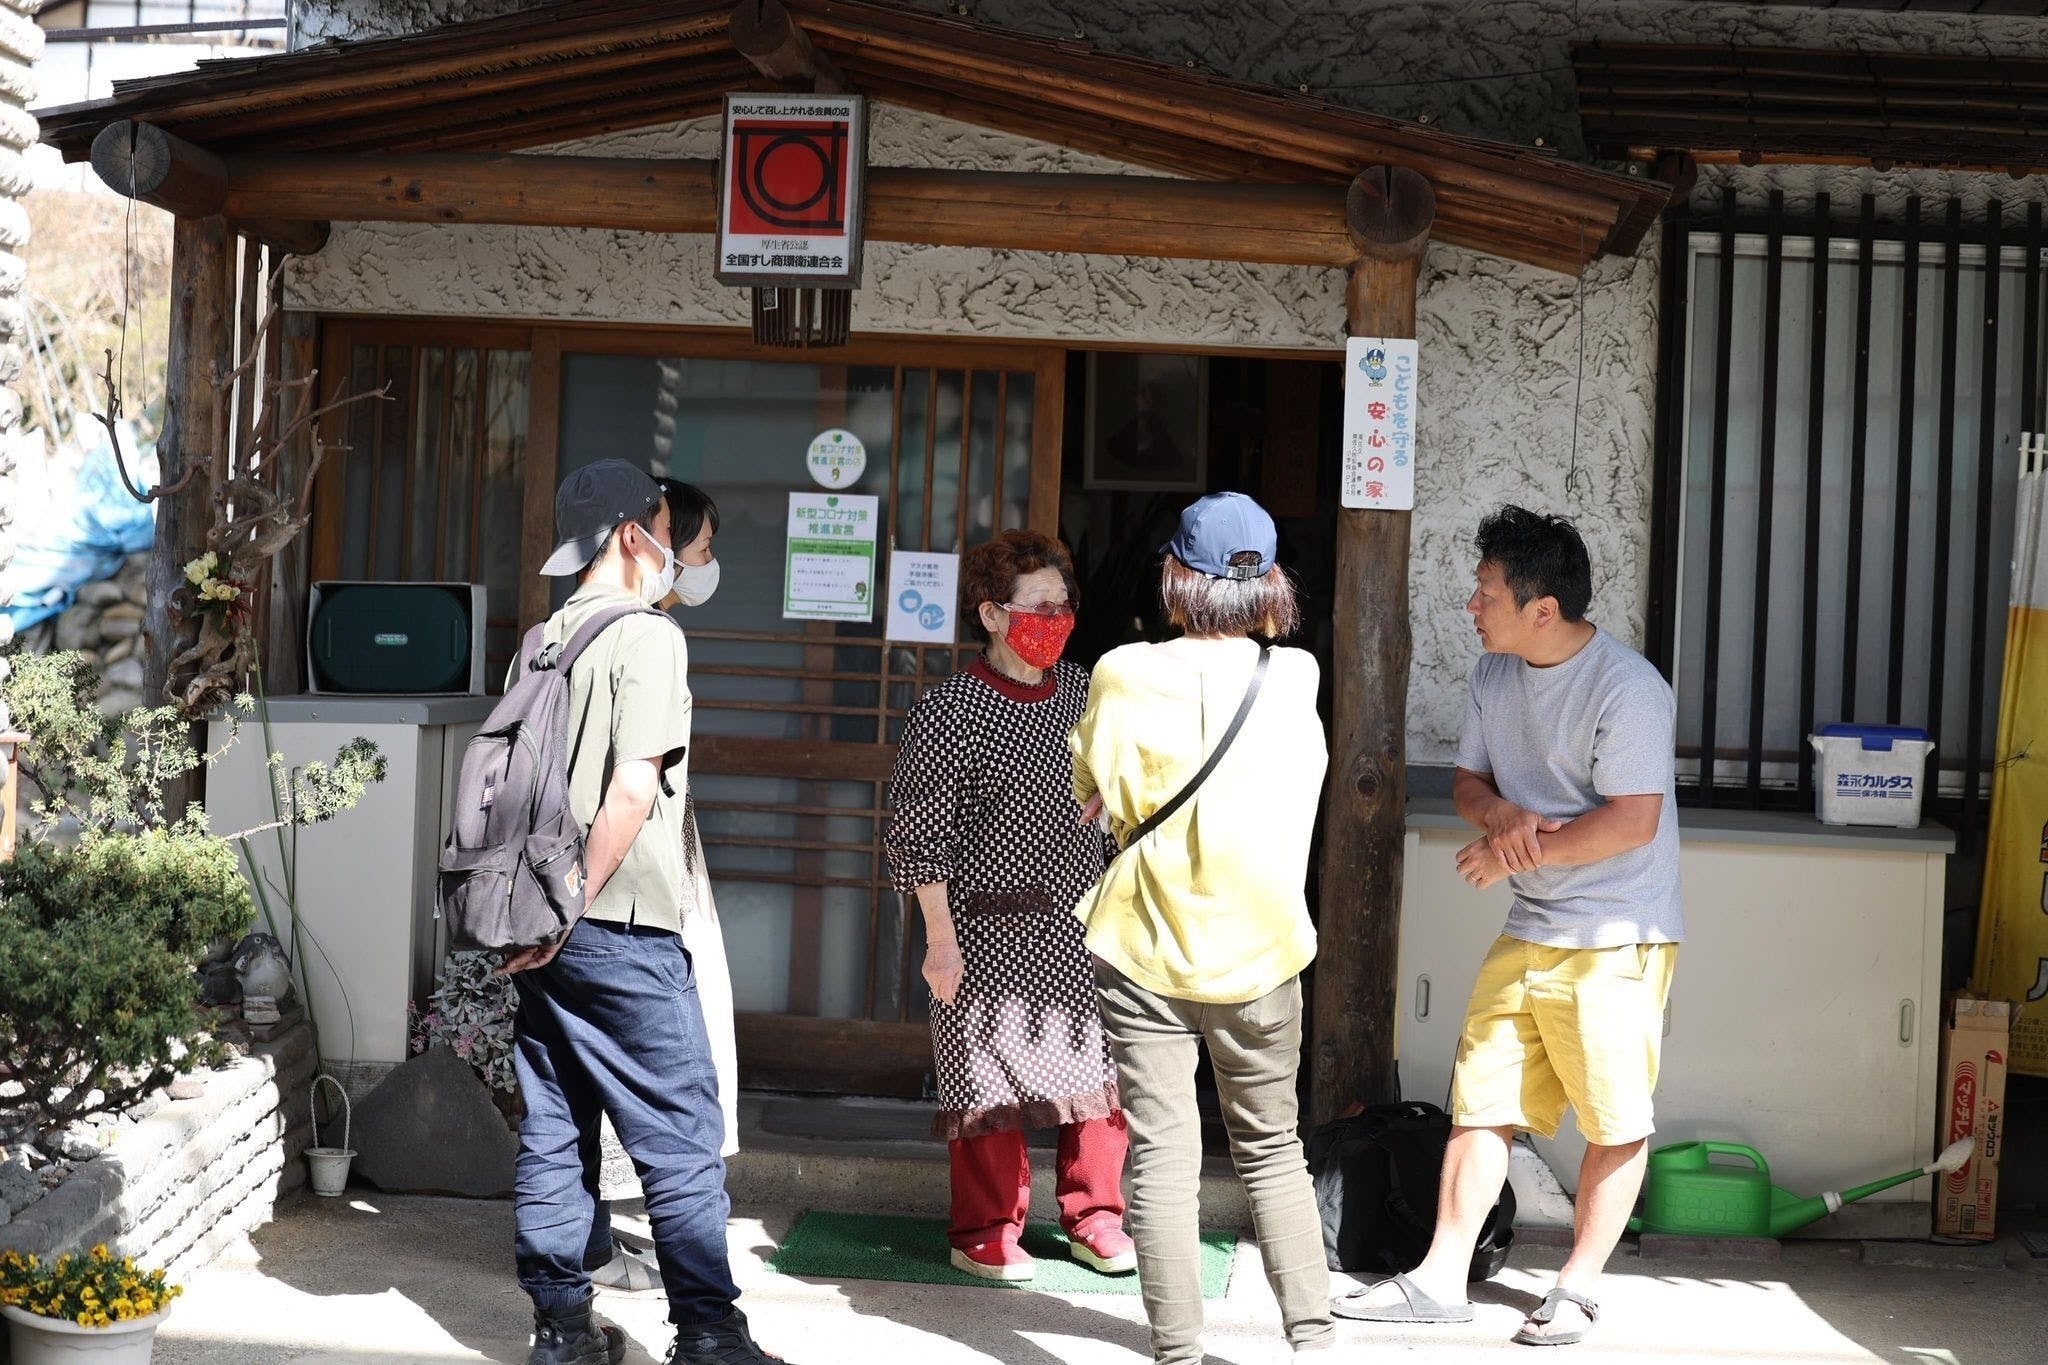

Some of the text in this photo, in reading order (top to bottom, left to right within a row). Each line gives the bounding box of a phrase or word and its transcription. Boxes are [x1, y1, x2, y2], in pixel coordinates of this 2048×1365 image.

[732, 105, 850, 117] 安心して召し上がれる会員の店
[761, 239, 809, 251] 厚生省公認
[725, 253, 843, 269] 全国すし商環衛連合会
[1391, 355, 1411, 467] こどもを守る
[1365, 401, 1386, 498] 安心の家
[796, 507, 868, 521] 新型コロナ対策
[808, 523, 854, 536] 推進宣言
[1836, 773, 1913, 789] 森永カルダス
[1862, 790, 1888, 799] 保冷箱
[1985, 1114, 1998, 1158] ミツウロコ
